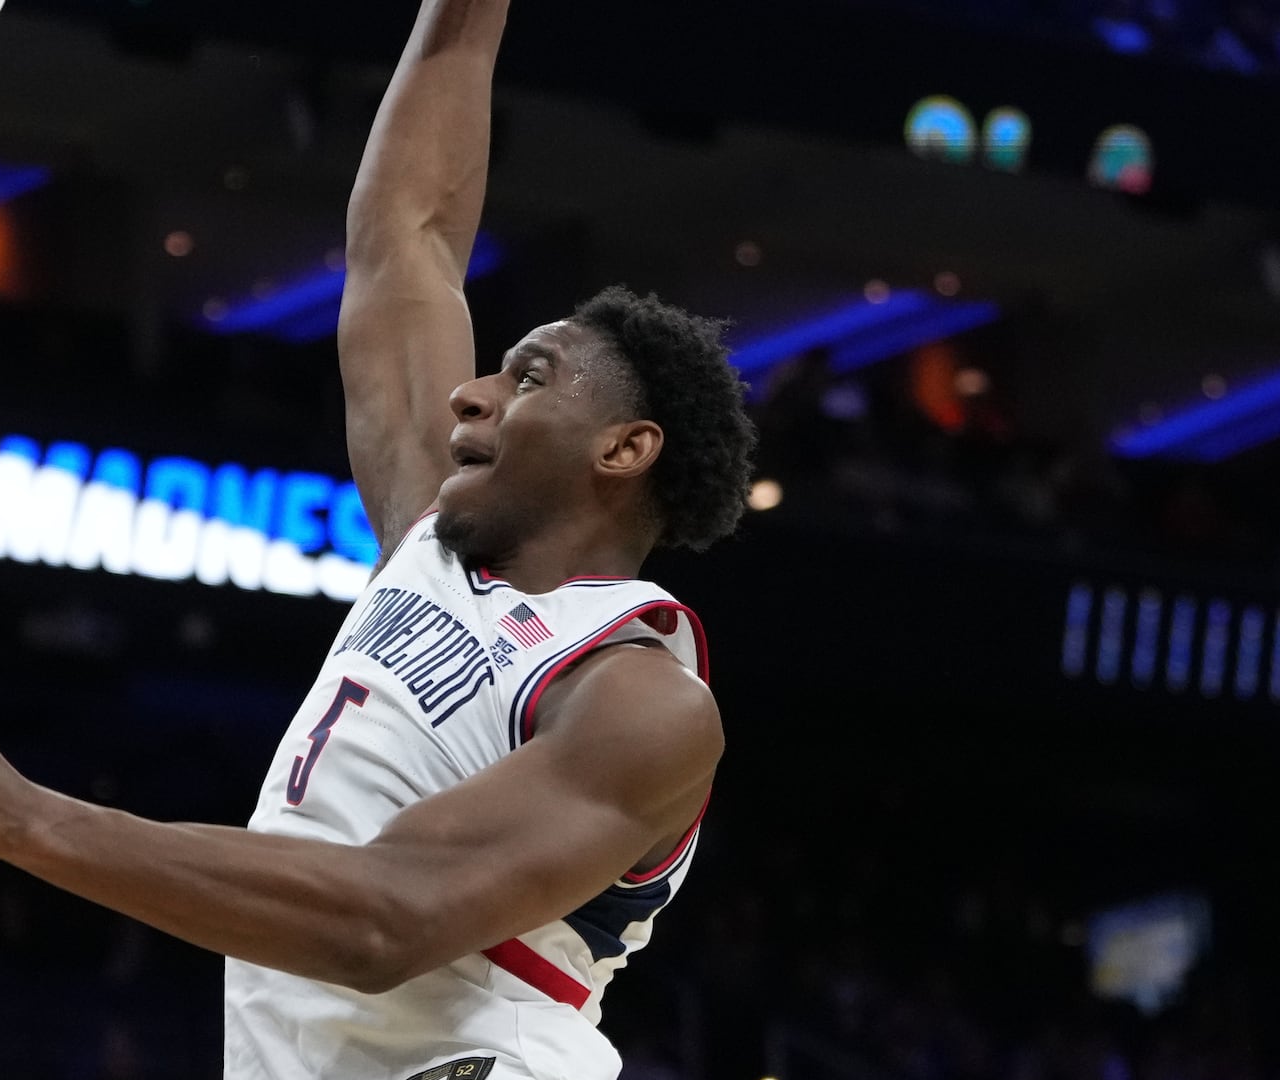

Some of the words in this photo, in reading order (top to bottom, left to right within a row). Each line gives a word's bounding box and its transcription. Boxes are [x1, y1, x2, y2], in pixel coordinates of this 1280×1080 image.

[494, 636, 518, 654] BIG
[286, 676, 370, 806] 5
[455, 1064, 475, 1077] 52
